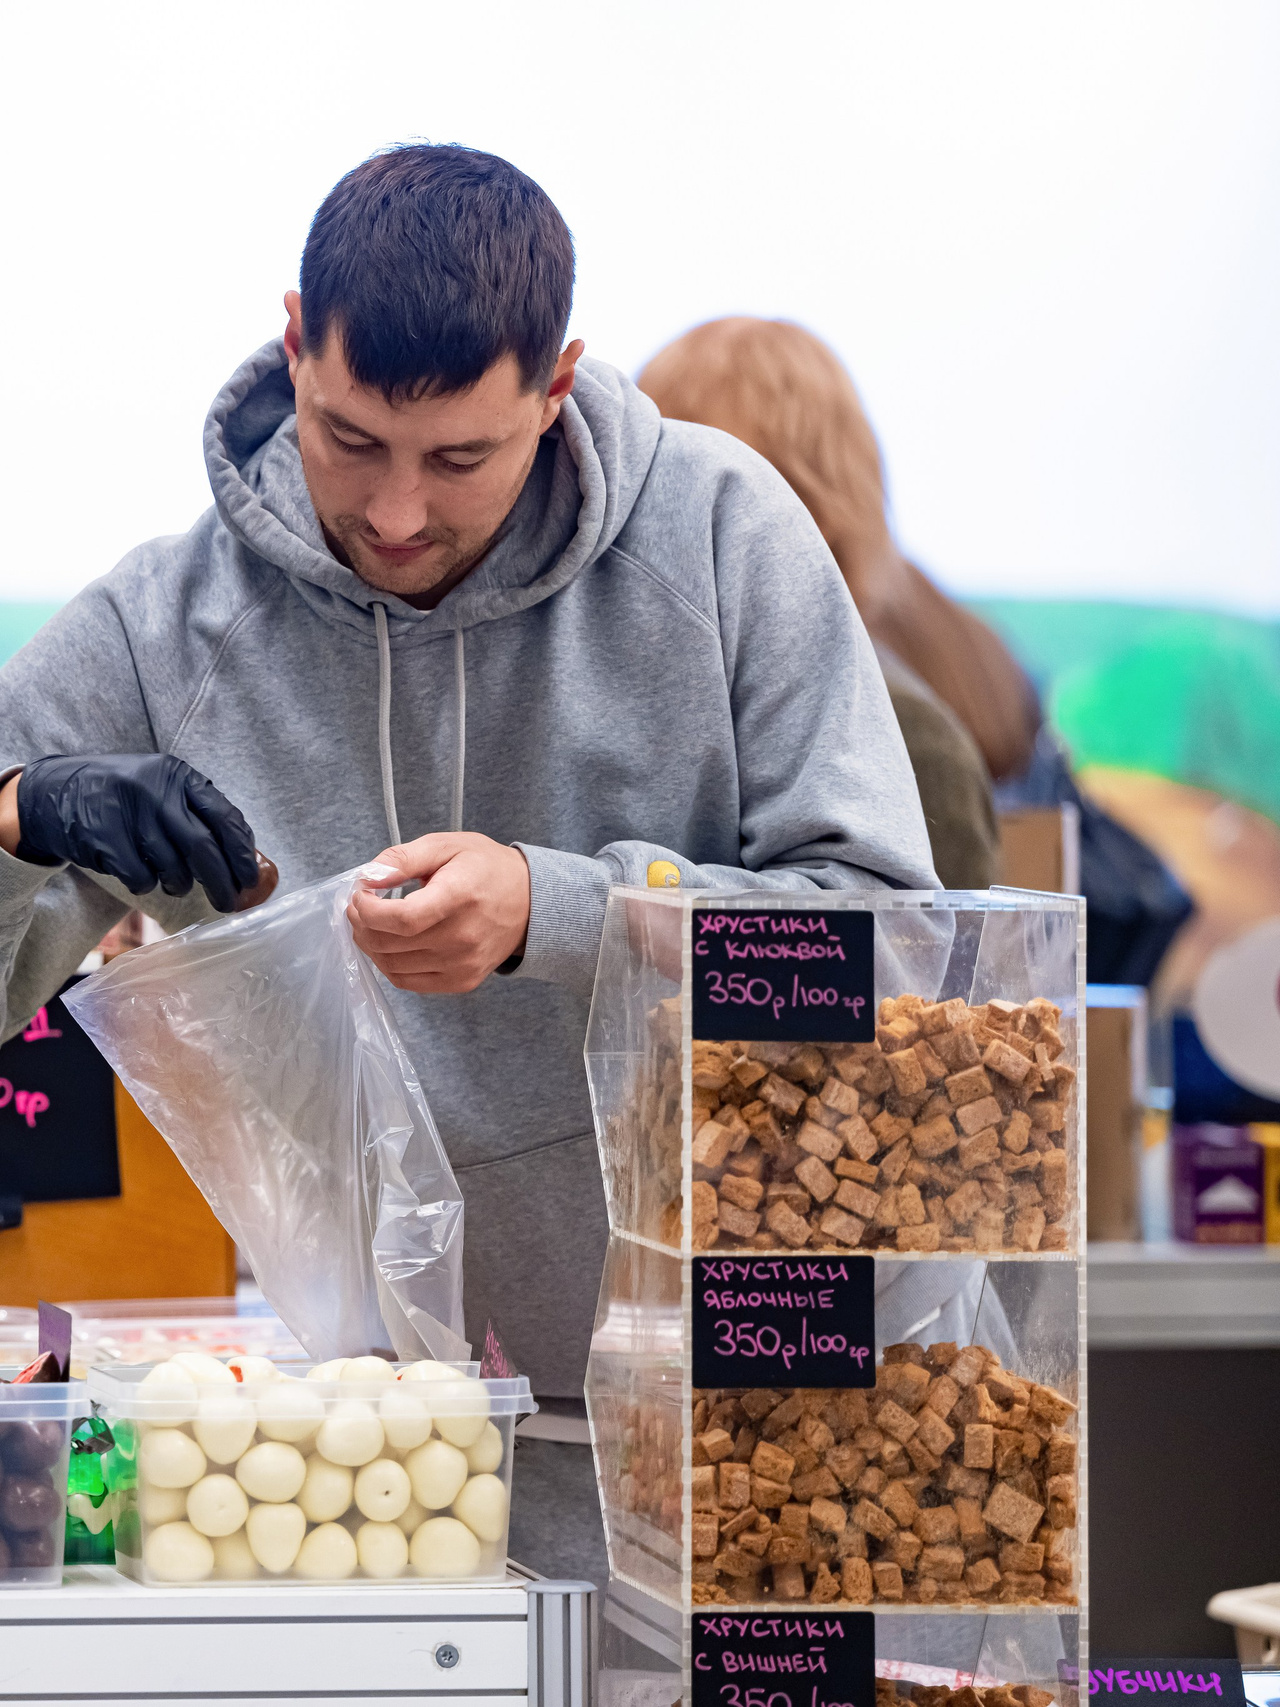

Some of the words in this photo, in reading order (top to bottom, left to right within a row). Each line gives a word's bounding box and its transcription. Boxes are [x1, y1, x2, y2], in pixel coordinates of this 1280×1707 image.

[697, 914, 828, 935] ХРУСТИКИ
[724, 935, 846, 960] КЛЮКВОЙ
[701, 1261, 849, 1281] ХРУСТИКИ
[703, 1289, 835, 1309] ЯБЛОЧНЫЕ
[699, 1616, 845, 1638] ХРУСТИКИ
[721, 1647, 828, 1673] ВИШНЕЙ
